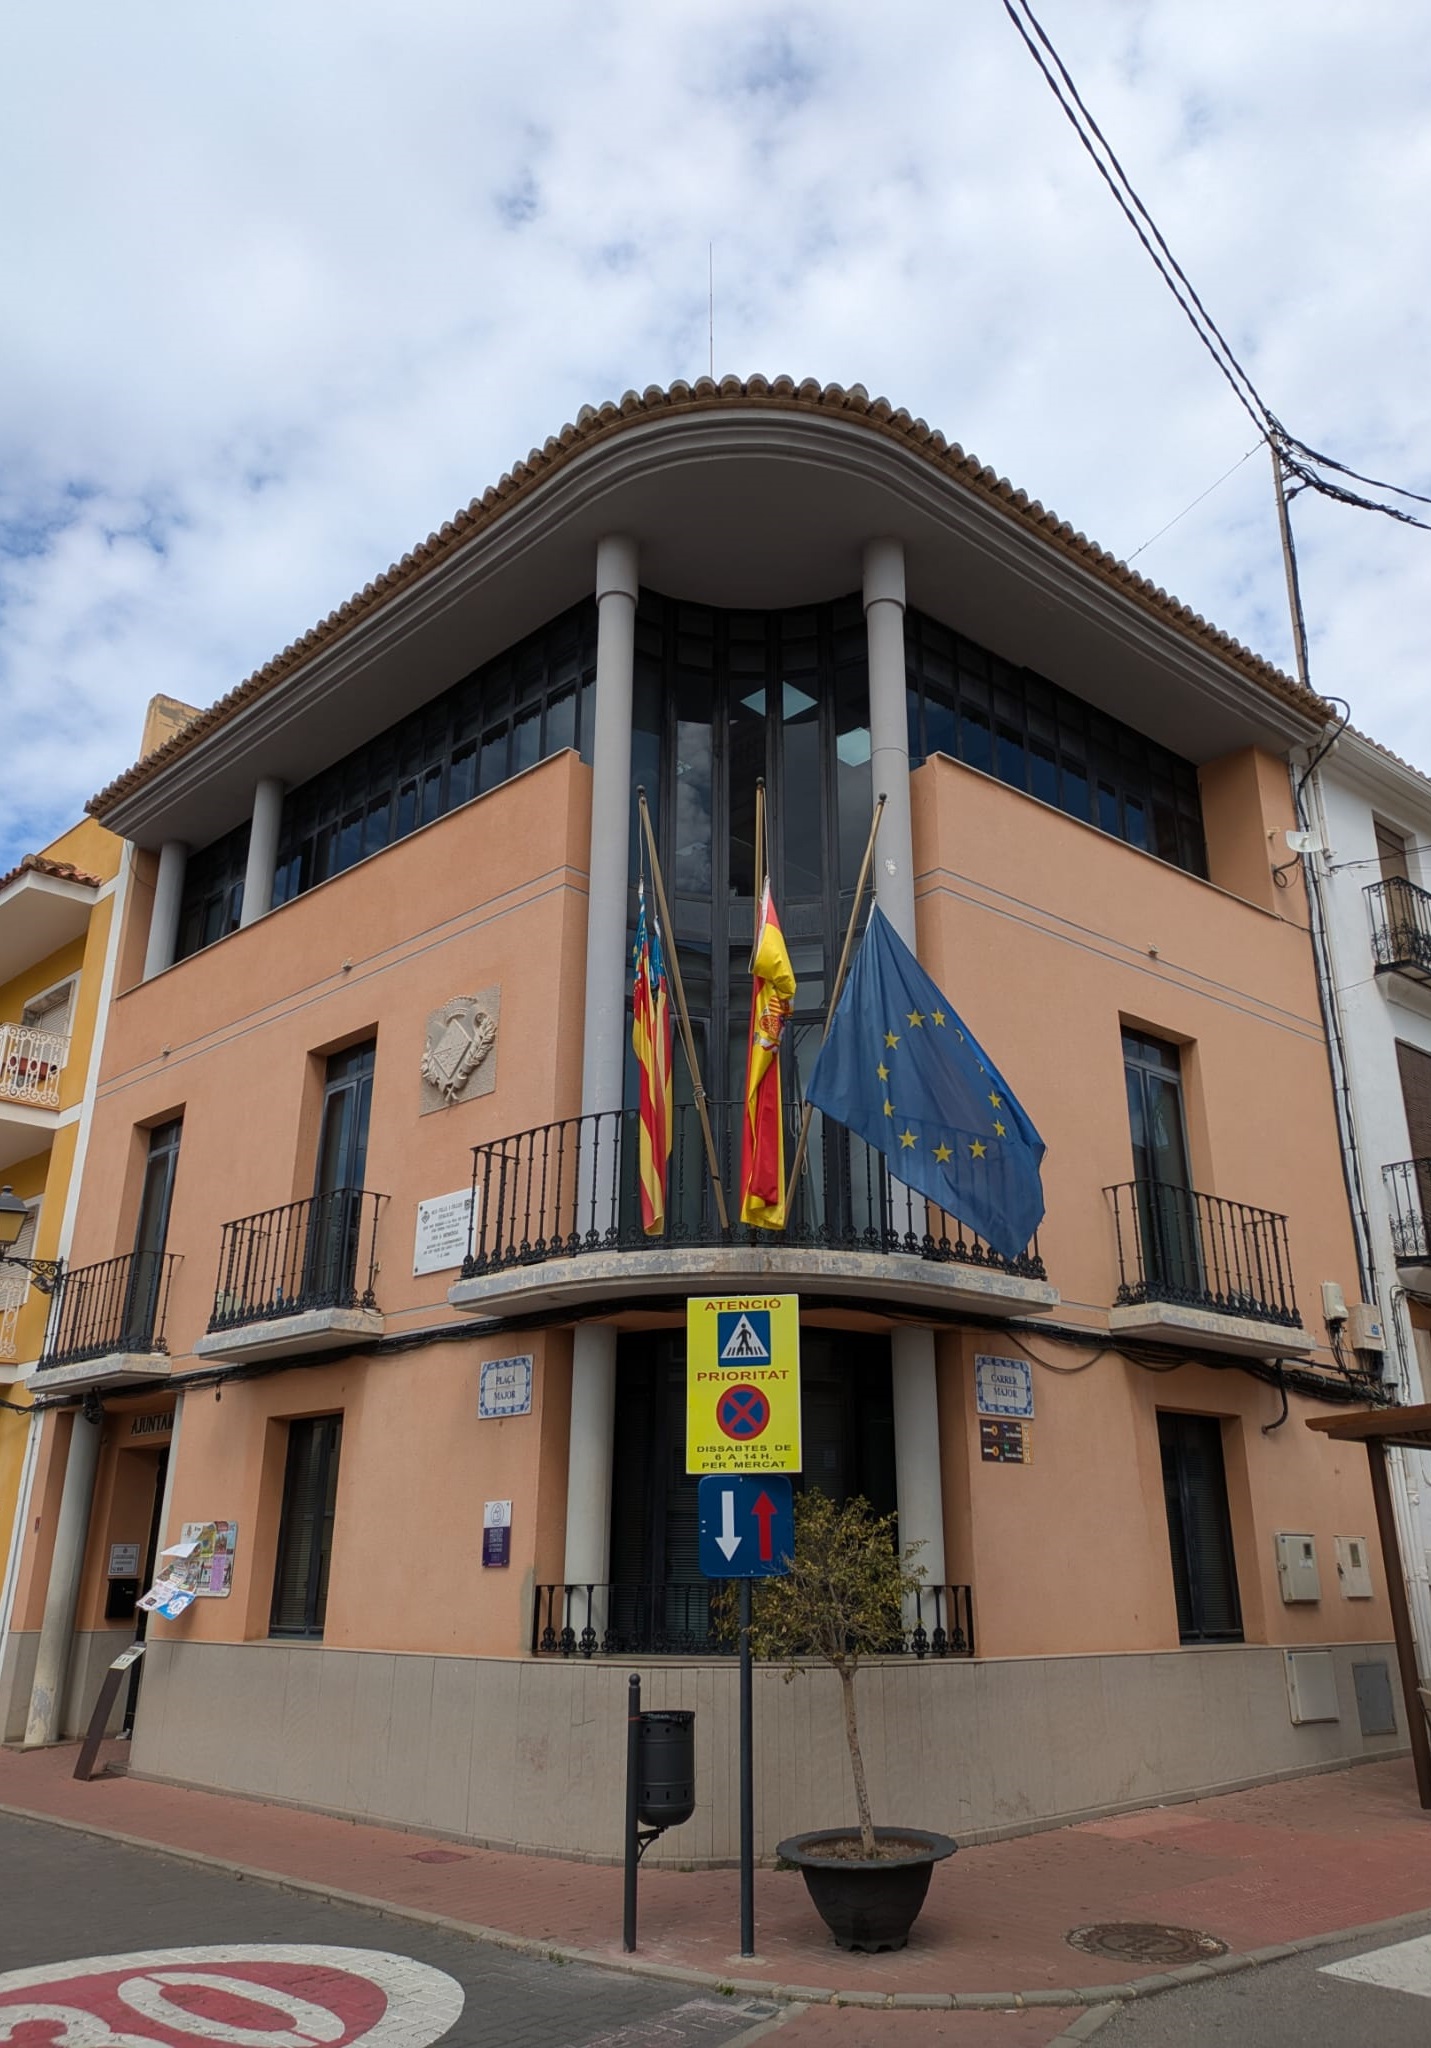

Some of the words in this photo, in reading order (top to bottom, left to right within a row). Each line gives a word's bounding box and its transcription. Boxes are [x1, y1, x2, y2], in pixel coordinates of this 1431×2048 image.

[705, 1298, 781, 1311] ATENCIÓ
[496, 1375, 515, 1385] PLAÇA
[697, 1370, 790, 1382] PRIORITAT
[991, 1374, 1018, 1384] CARRER
[494, 1390, 515, 1400] MAJOR
[993, 1387, 1018, 1398] MAJOR
[697, 1445, 768, 1453] DISSABTES
[775, 1444, 792, 1452] DE
[715, 1453, 722, 1461] 6
[728, 1453, 737, 1461] A
[734, 1461, 787, 1469] MERCAT
